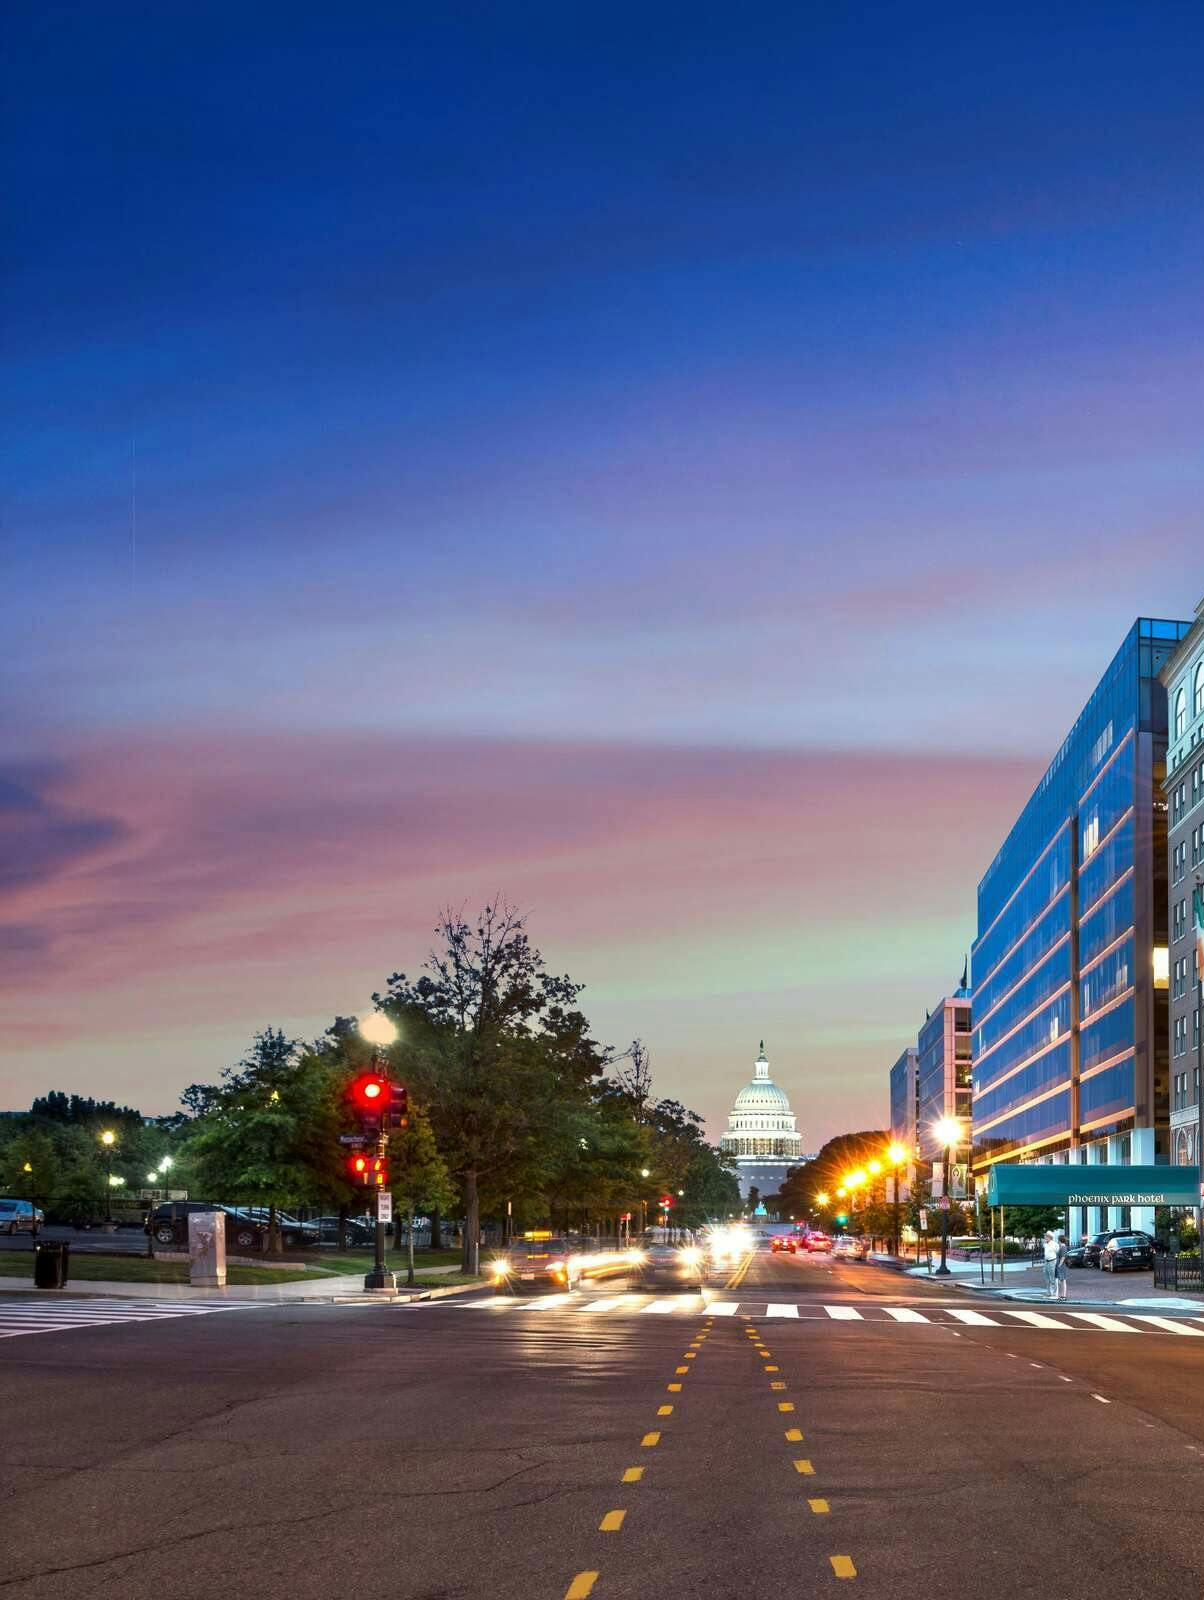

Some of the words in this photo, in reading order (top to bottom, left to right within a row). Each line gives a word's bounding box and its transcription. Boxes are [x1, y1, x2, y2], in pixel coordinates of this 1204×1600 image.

[1068, 1194, 1109, 1204] phoenix
[1111, 1194, 1135, 1204] park
[1137, 1194, 1164, 1203] hotel
